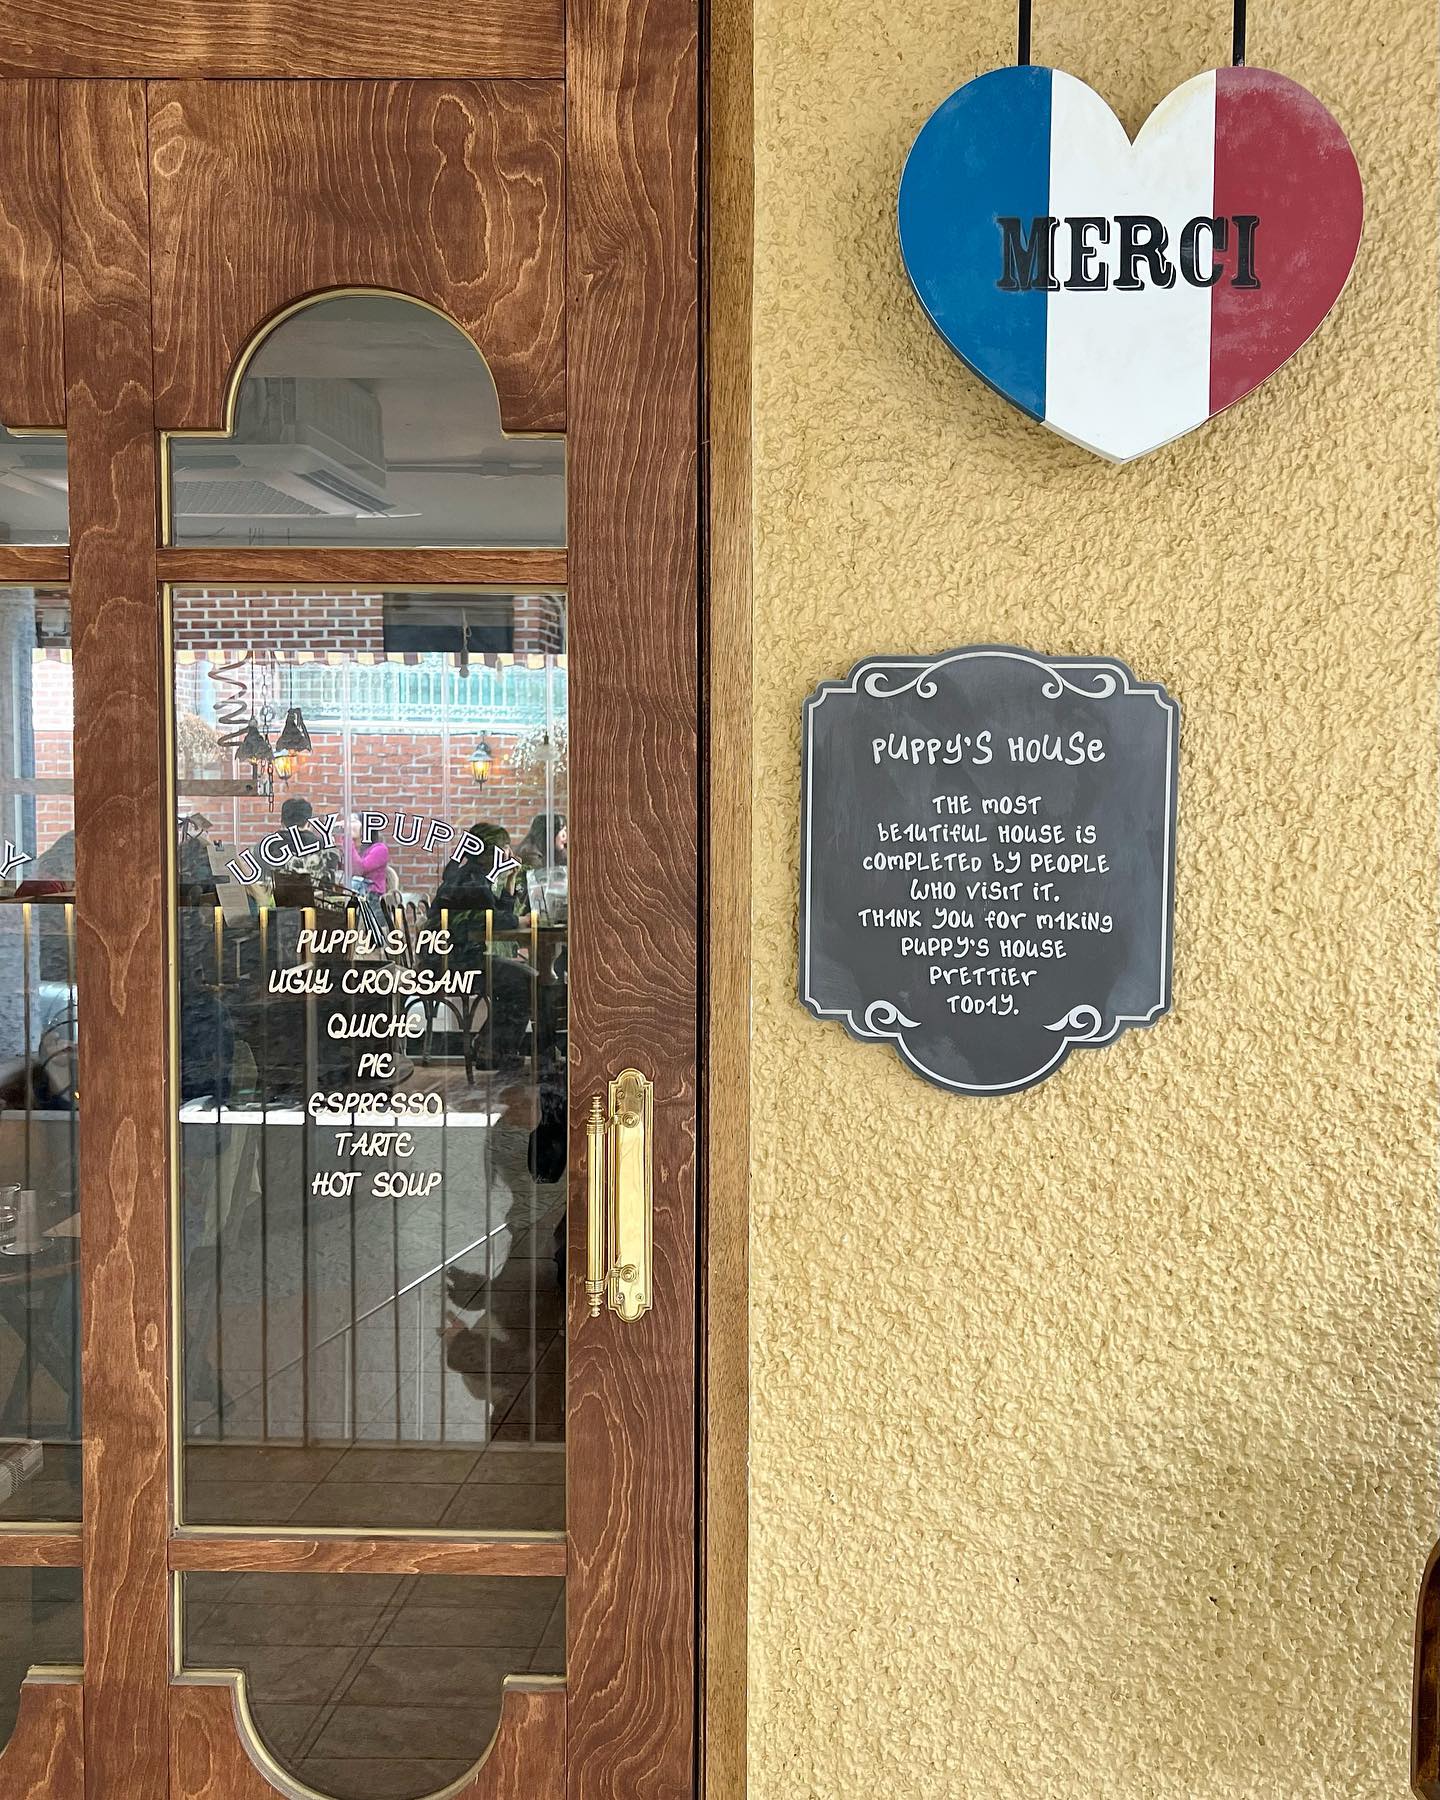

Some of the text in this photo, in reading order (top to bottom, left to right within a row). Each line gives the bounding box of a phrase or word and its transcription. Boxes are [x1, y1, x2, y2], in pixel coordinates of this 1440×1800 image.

[996, 215, 1261, 291] MERCI
[871, 730, 993, 765] PUPPY'S
[932, 795, 972, 815] THE
[997, 825, 1065, 844] HOUSE
[226, 810, 521, 886] UGLY PUPPY
[1030, 853, 1110, 874] PEOPLE
[910, 878, 956, 901] WHO
[857, 908, 921, 928] THANK
[416, 929, 453, 954] PIE
[901, 936, 1067, 959] PUPPY'S HOUSE
[268, 968, 482, 995] UGLY CROISSANT
[327, 1012, 425, 1039] QUICHE
[357, 1052, 395, 1078] PIE
[308, 1092, 444, 1117] ESPRESSO
[335, 1132, 415, 1157] TARTE
[311, 1172, 442, 1198] HOT SOUP
